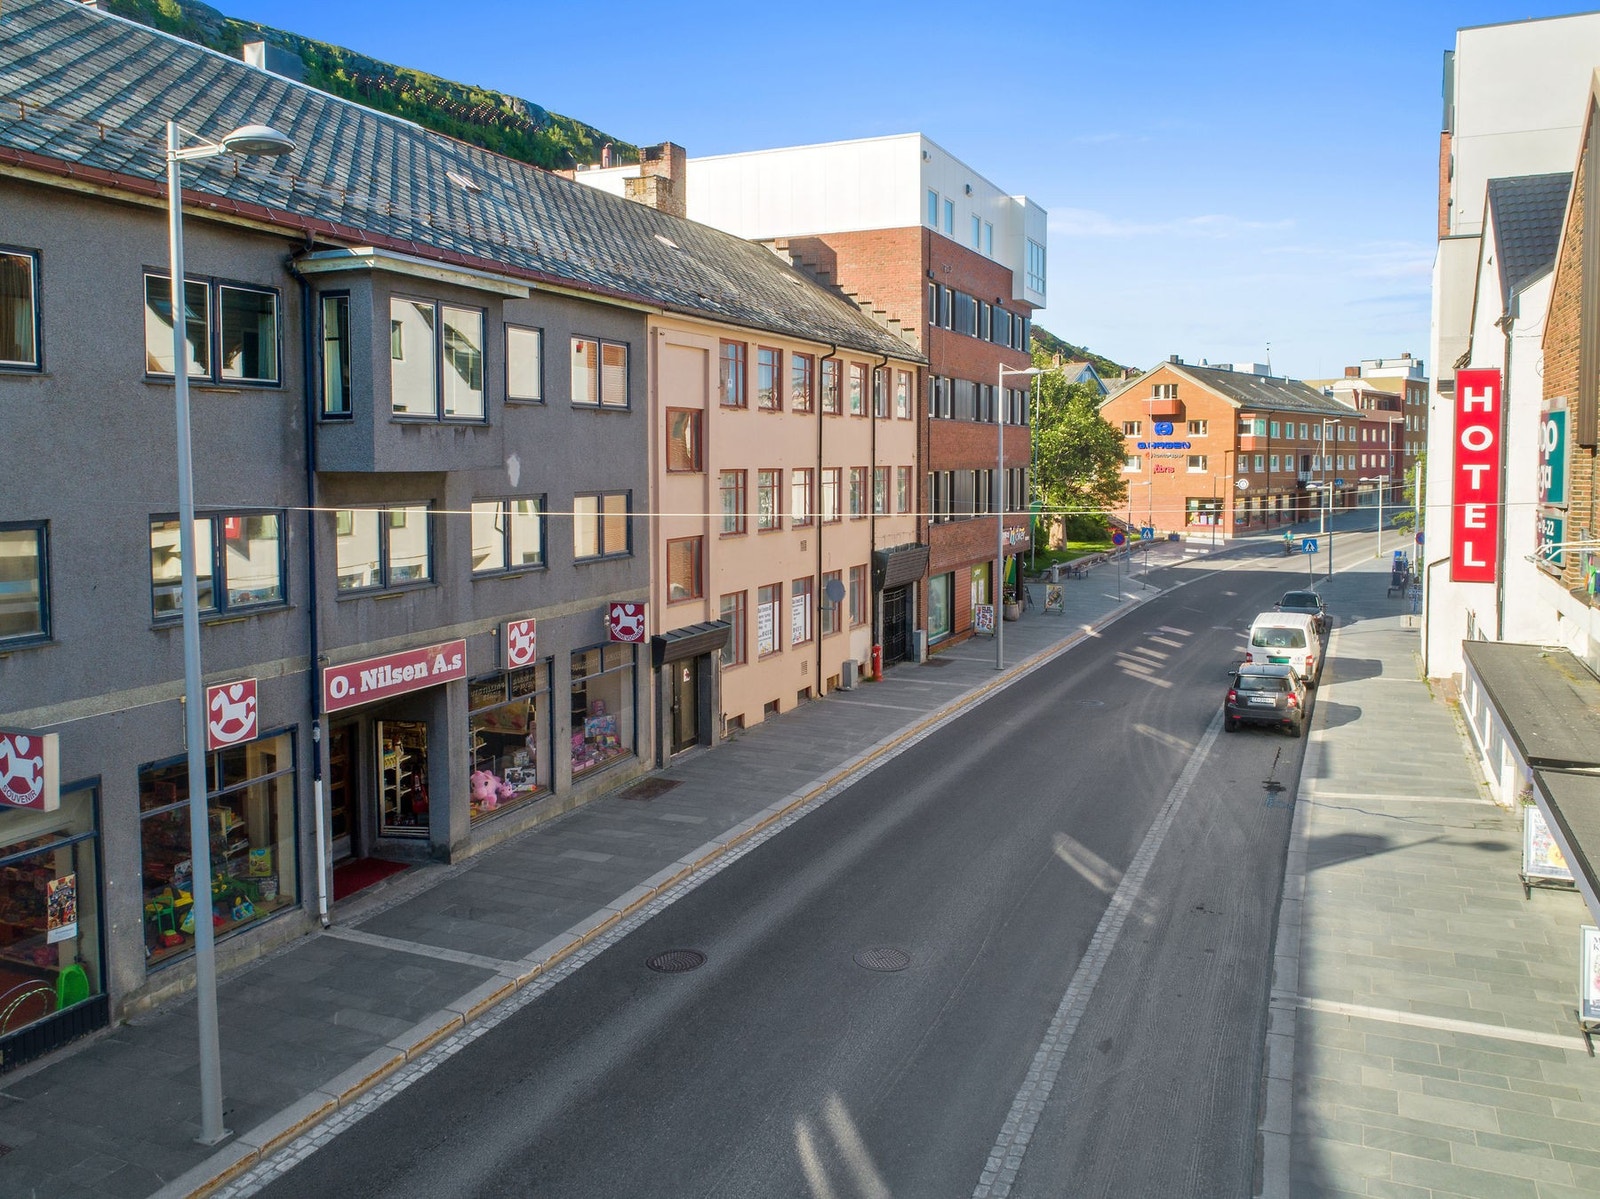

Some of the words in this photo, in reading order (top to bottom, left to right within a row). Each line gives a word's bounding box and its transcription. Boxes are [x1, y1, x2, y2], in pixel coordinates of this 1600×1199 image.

[1460, 386, 1493, 567] HOTEL
[329, 675, 356, 699] O.
[360, 661, 428, 692] Nilsen
[432, 653, 462, 675] A.s
[2, 784, 37, 803] SOUVENIR
